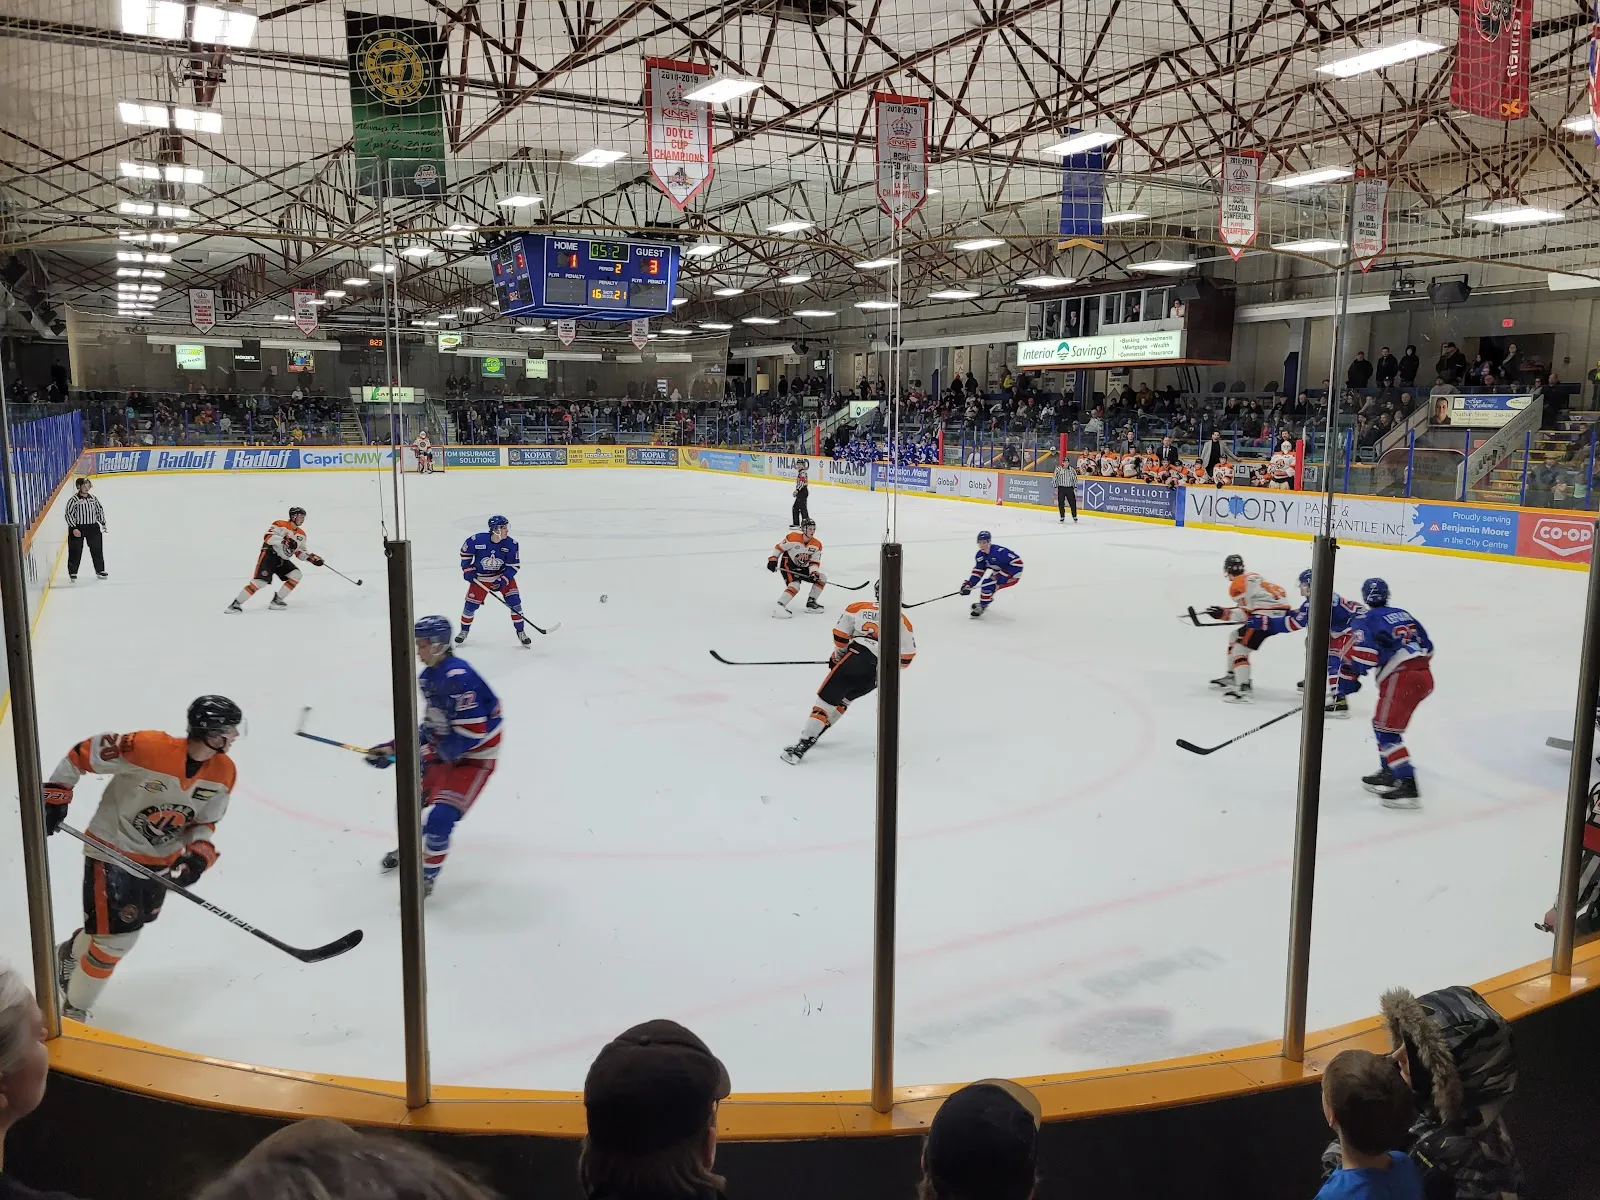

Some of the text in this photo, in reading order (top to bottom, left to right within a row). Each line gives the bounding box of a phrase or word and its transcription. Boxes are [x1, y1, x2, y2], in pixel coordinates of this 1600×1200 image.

[368, 44, 382, 60] WE
[369, 69, 389, 92] FOR
[661, 70, 699, 84] 2018-2019
[662, 108, 699, 122] KINGS
[887, 104, 918, 115] 2018-2019
[665, 126, 694, 140] DOYLE
[670, 139, 689, 150] CUP
[888, 136, 918, 151] KINGS
[653, 149, 706, 163] CHAMPIONS
[895, 171, 909, 181] CP
[1228, 183, 1252, 193] KINGS
[1228, 203, 1249, 213] COASTAL
[1223, 210, 1252, 221] CONFERENCE
[554, 241, 578, 251] HOME
[636, 247, 665, 258] GUEST
[570, 253, 577, 268] 1
[649, 259, 658, 274] 3
[614, 263, 622, 274] 2
[565, 272, 586, 280] PENALTY
[647, 278, 667, 286] PENALTY
[598, 279, 619, 287] PENALTY
[592, 288, 602, 299] 16
[613, 289, 627, 300] 21
[1122, 337, 1140, 345] Banking
[1022, 345, 1107, 360] Interior Savings
[1120, 350, 1146, 358] Commercial
[157, 450, 217, 469] Radloff
[232, 449, 291, 469] Radloff
[303, 452, 382, 466] CapriCMW
[459, 450, 496, 458] INSURANCE
[524, 451, 552, 460] KOPAR
[641, 451, 666, 460] KOPAR
[98, 450, 142, 472] Radloff
[777, 456, 810, 470] INLAD
[829, 460, 867, 477] INLAND
[911, 468, 929, 478] Meier
[937, 477, 955, 487] Global
[968, 480, 988, 491] Global
[1014, 479, 1039, 488] successful
[1009, 492, 1022, 500] starts
[1108, 484, 1172, 500] LO ELLIOTT
[1190, 493, 1295, 525] VICTORY
[1341, 506, 1350, 517] &
[1452, 511, 1511, 525] Proudly serving
[1382, 522, 1408, 538] INC.
[1441, 522, 1510, 537] Benjamin Moore
[1539, 526, 1592, 542] CO-OP
[1451, 537, 1464, 545] the
[1465, 538, 1481, 549] City
[1482, 540, 1509, 550] Centre
[100, 732, 121, 762] 20
